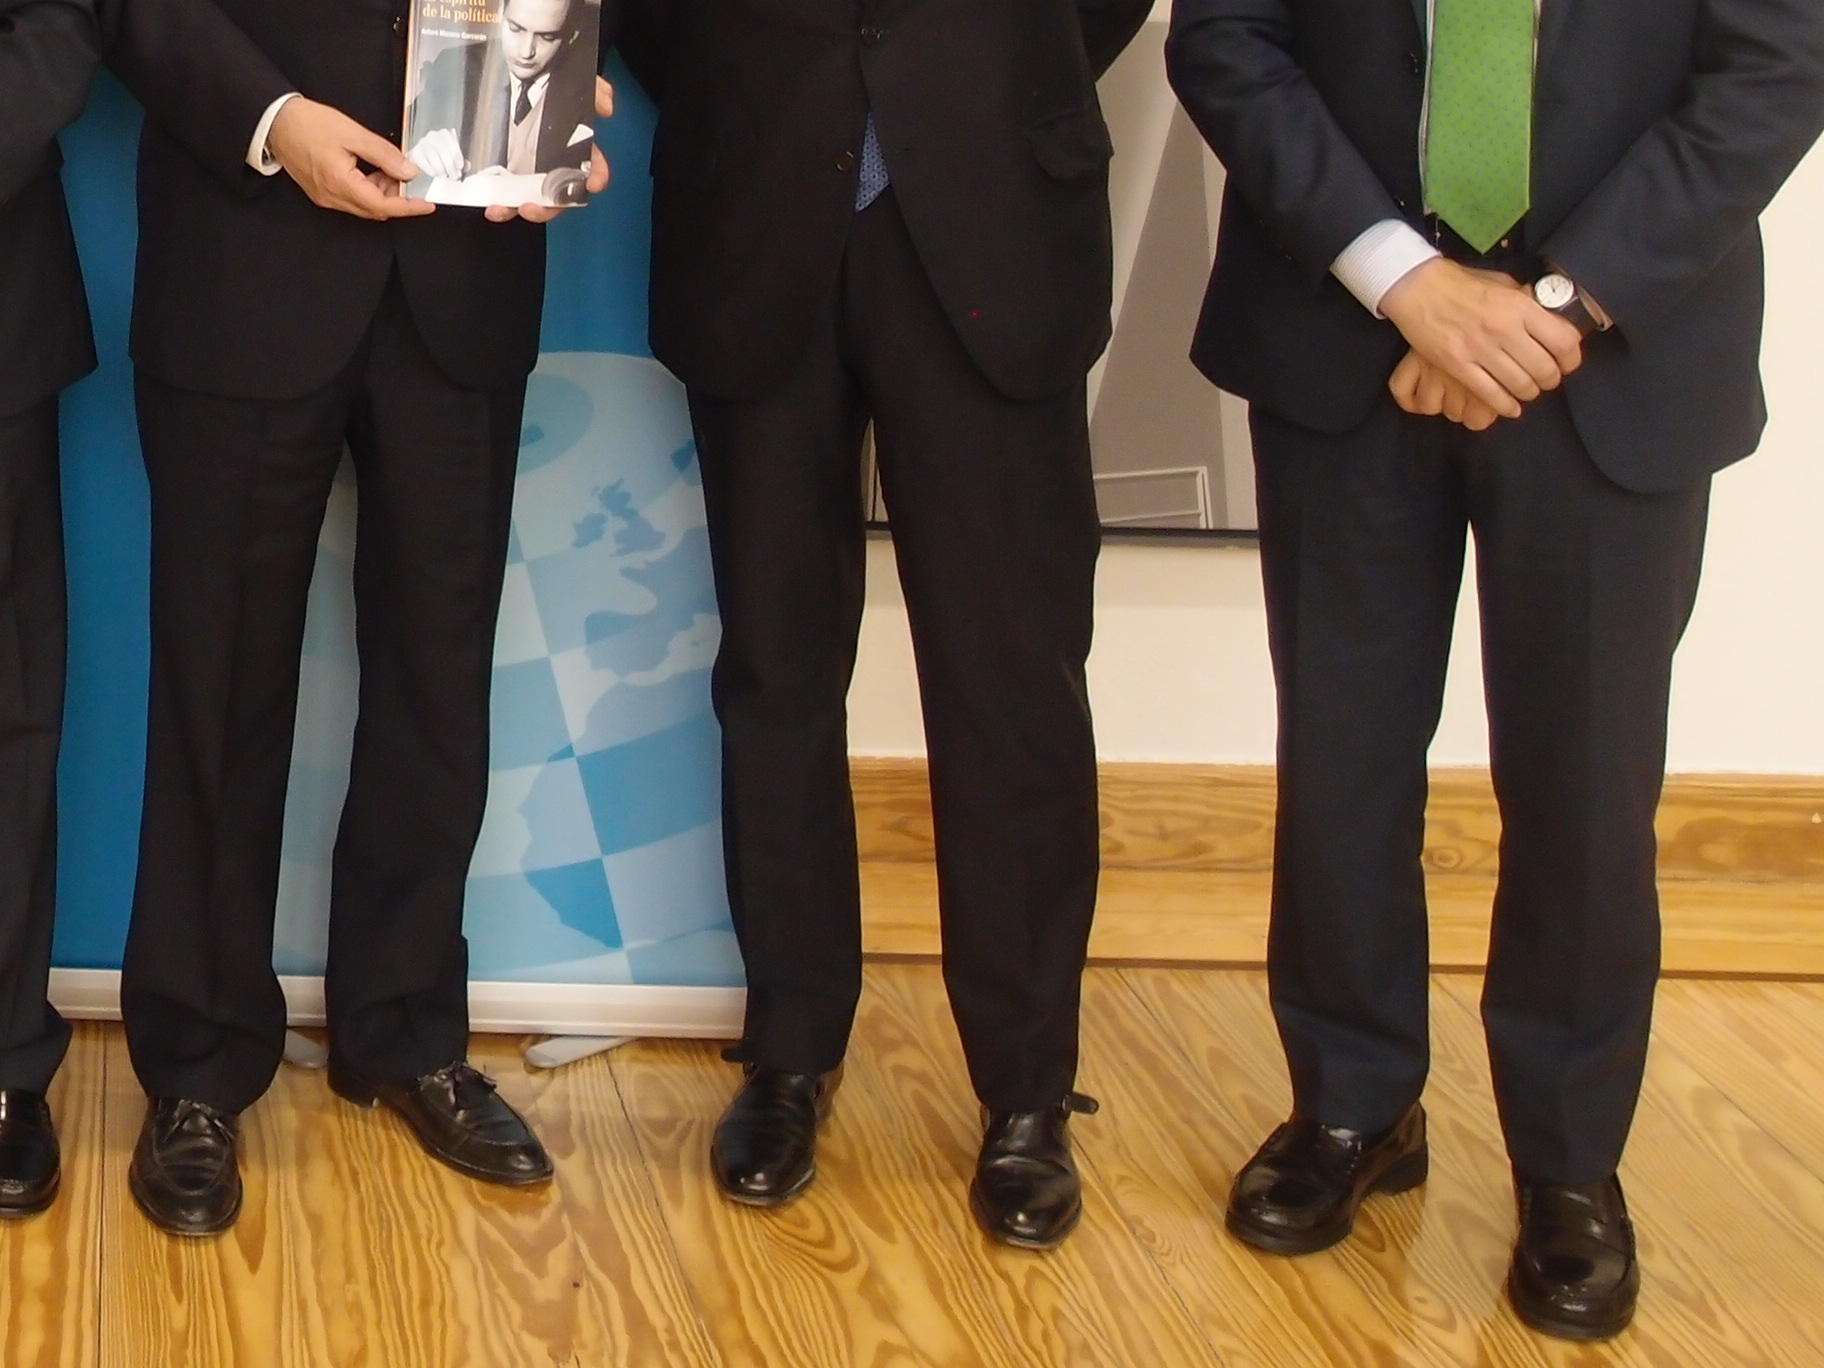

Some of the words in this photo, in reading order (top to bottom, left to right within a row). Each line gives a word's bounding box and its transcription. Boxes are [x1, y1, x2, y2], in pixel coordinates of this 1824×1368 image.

[422, 3, 437, 18] de
[440, 4, 451, 20] la
[453, 7, 501, 24] política
